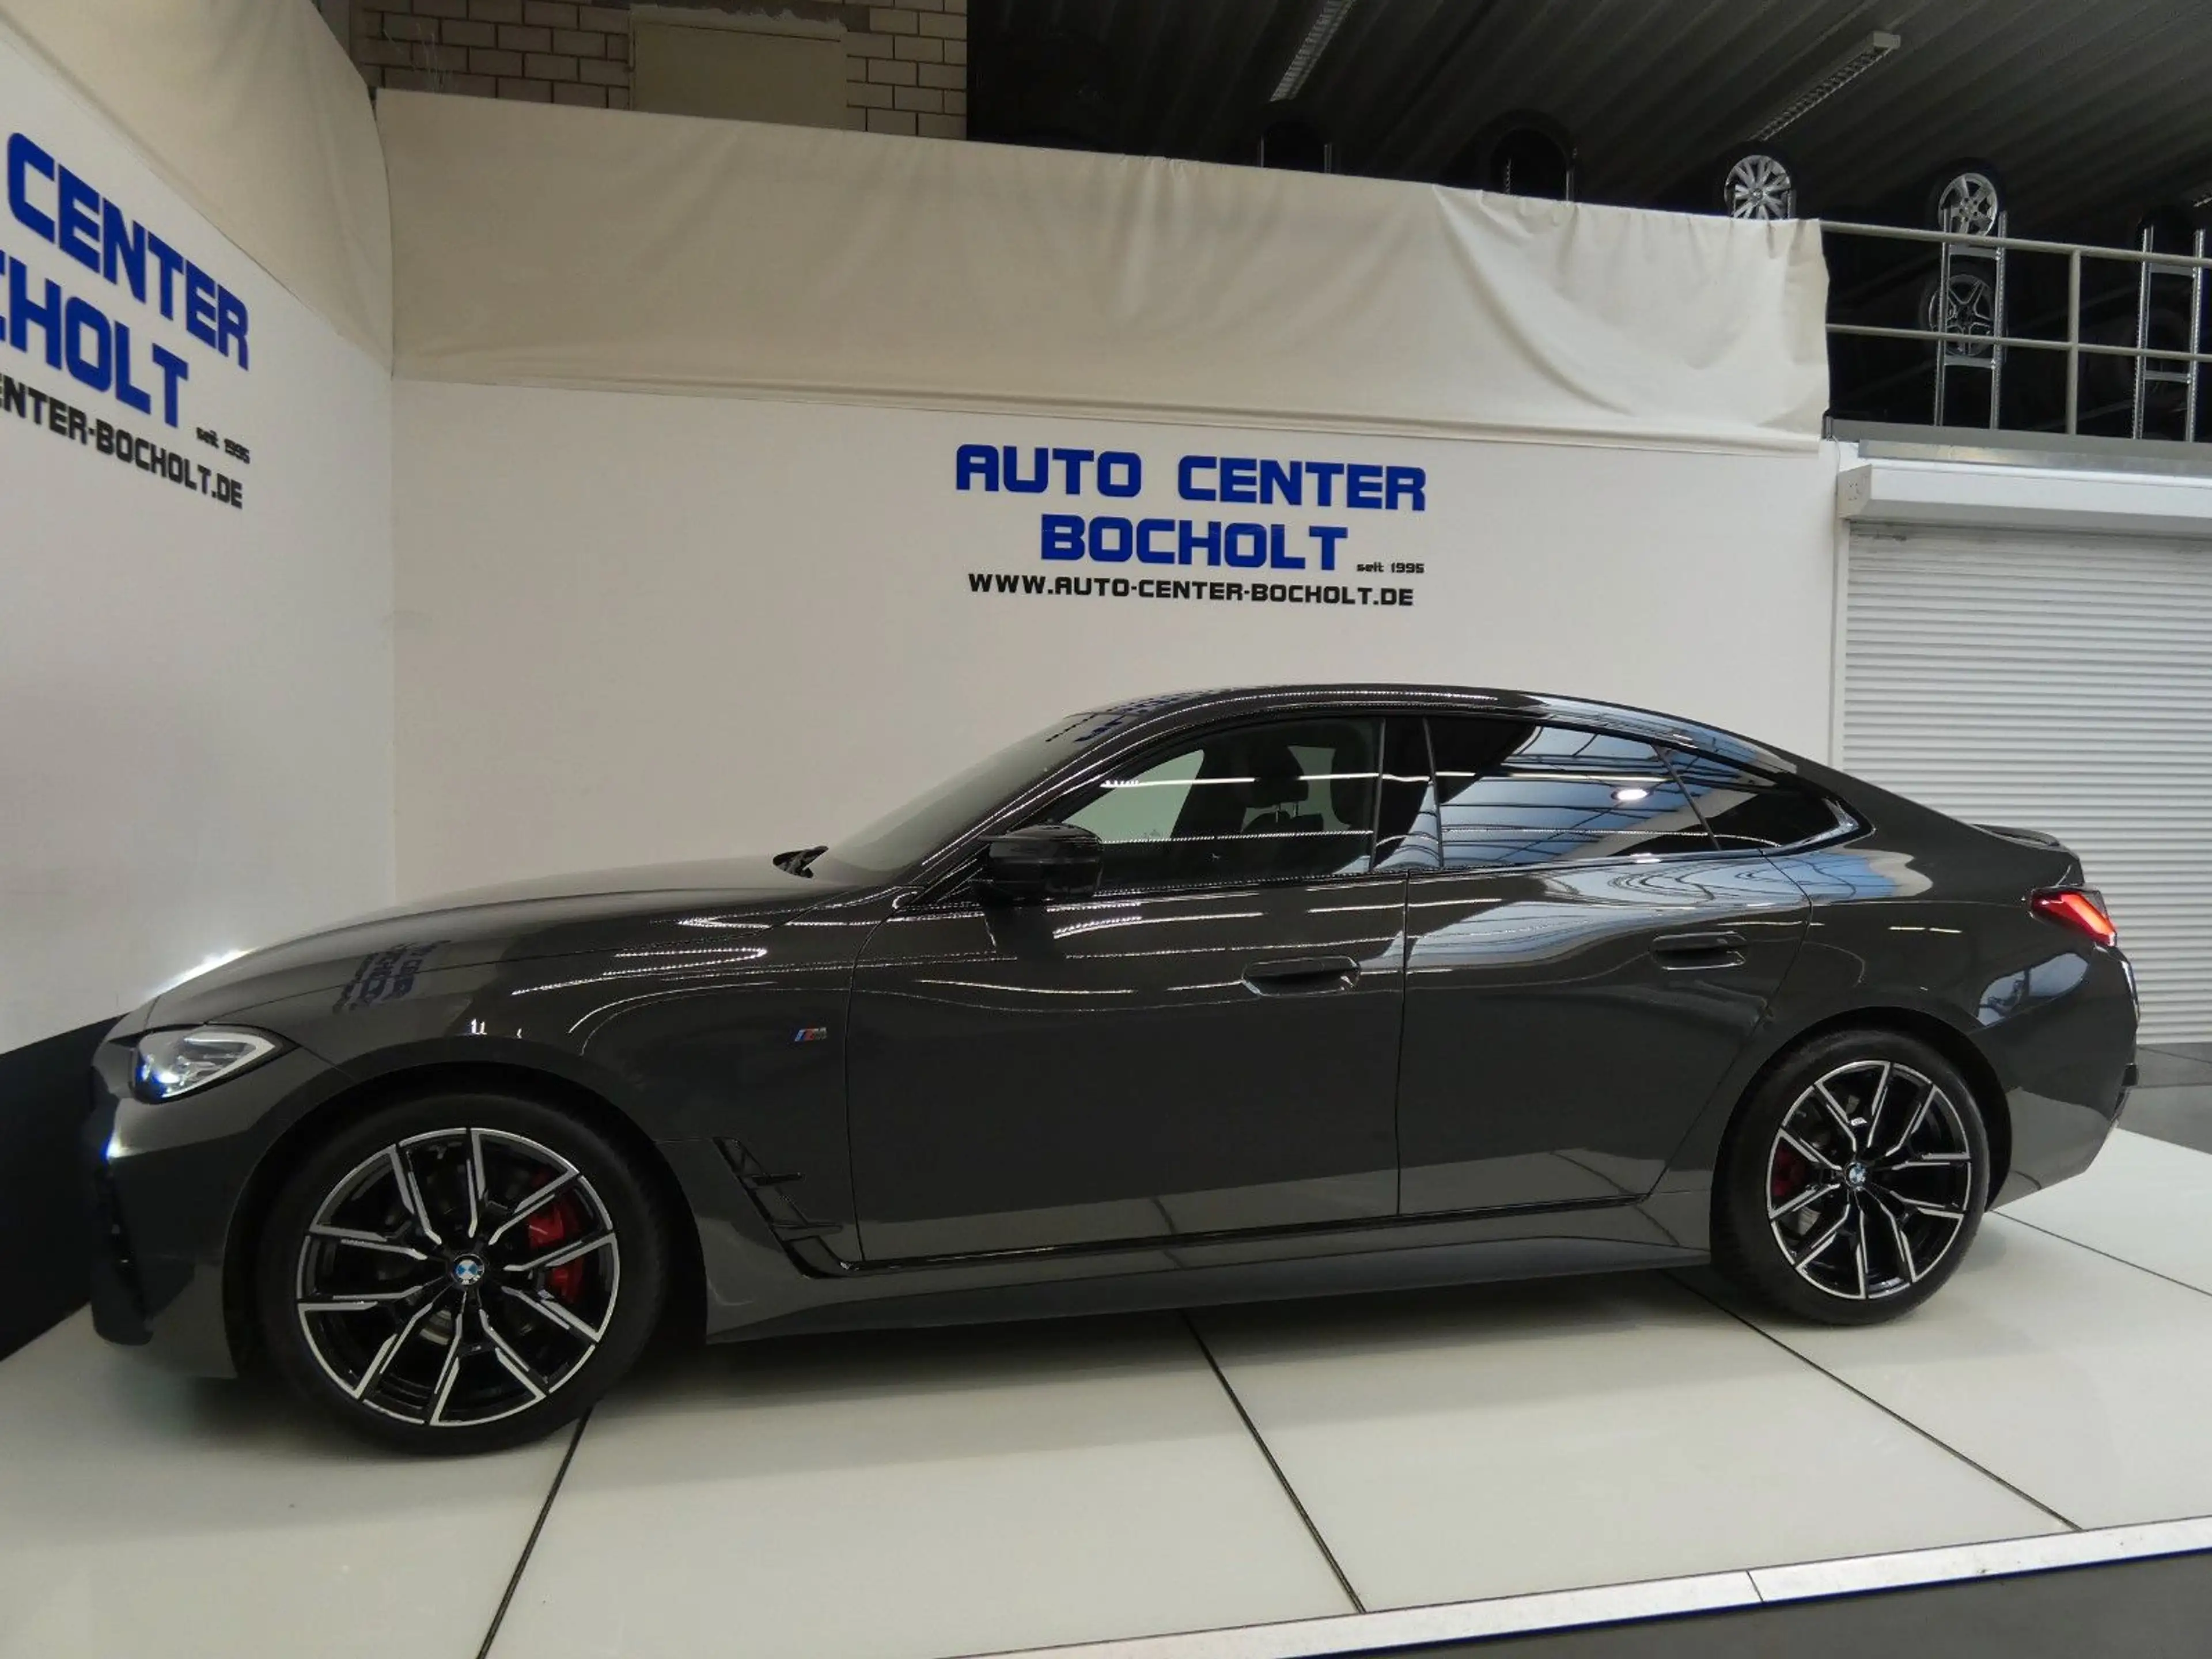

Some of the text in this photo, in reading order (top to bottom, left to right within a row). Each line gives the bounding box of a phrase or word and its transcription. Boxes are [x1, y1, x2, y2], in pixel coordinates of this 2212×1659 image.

[7, 132, 249, 371] CENTER
[0, 249, 188, 427] HOLT
[0, 373, 243, 509] NTER-BOCHOLT.DE
[956, 444, 1426, 511] AUTO CENTER
[968, 573, 1414, 607] WWW.AUTO-CENTER-BOCHOLT.DE
[1041, 514, 1425, 574] BOCHOLT seit 1995
